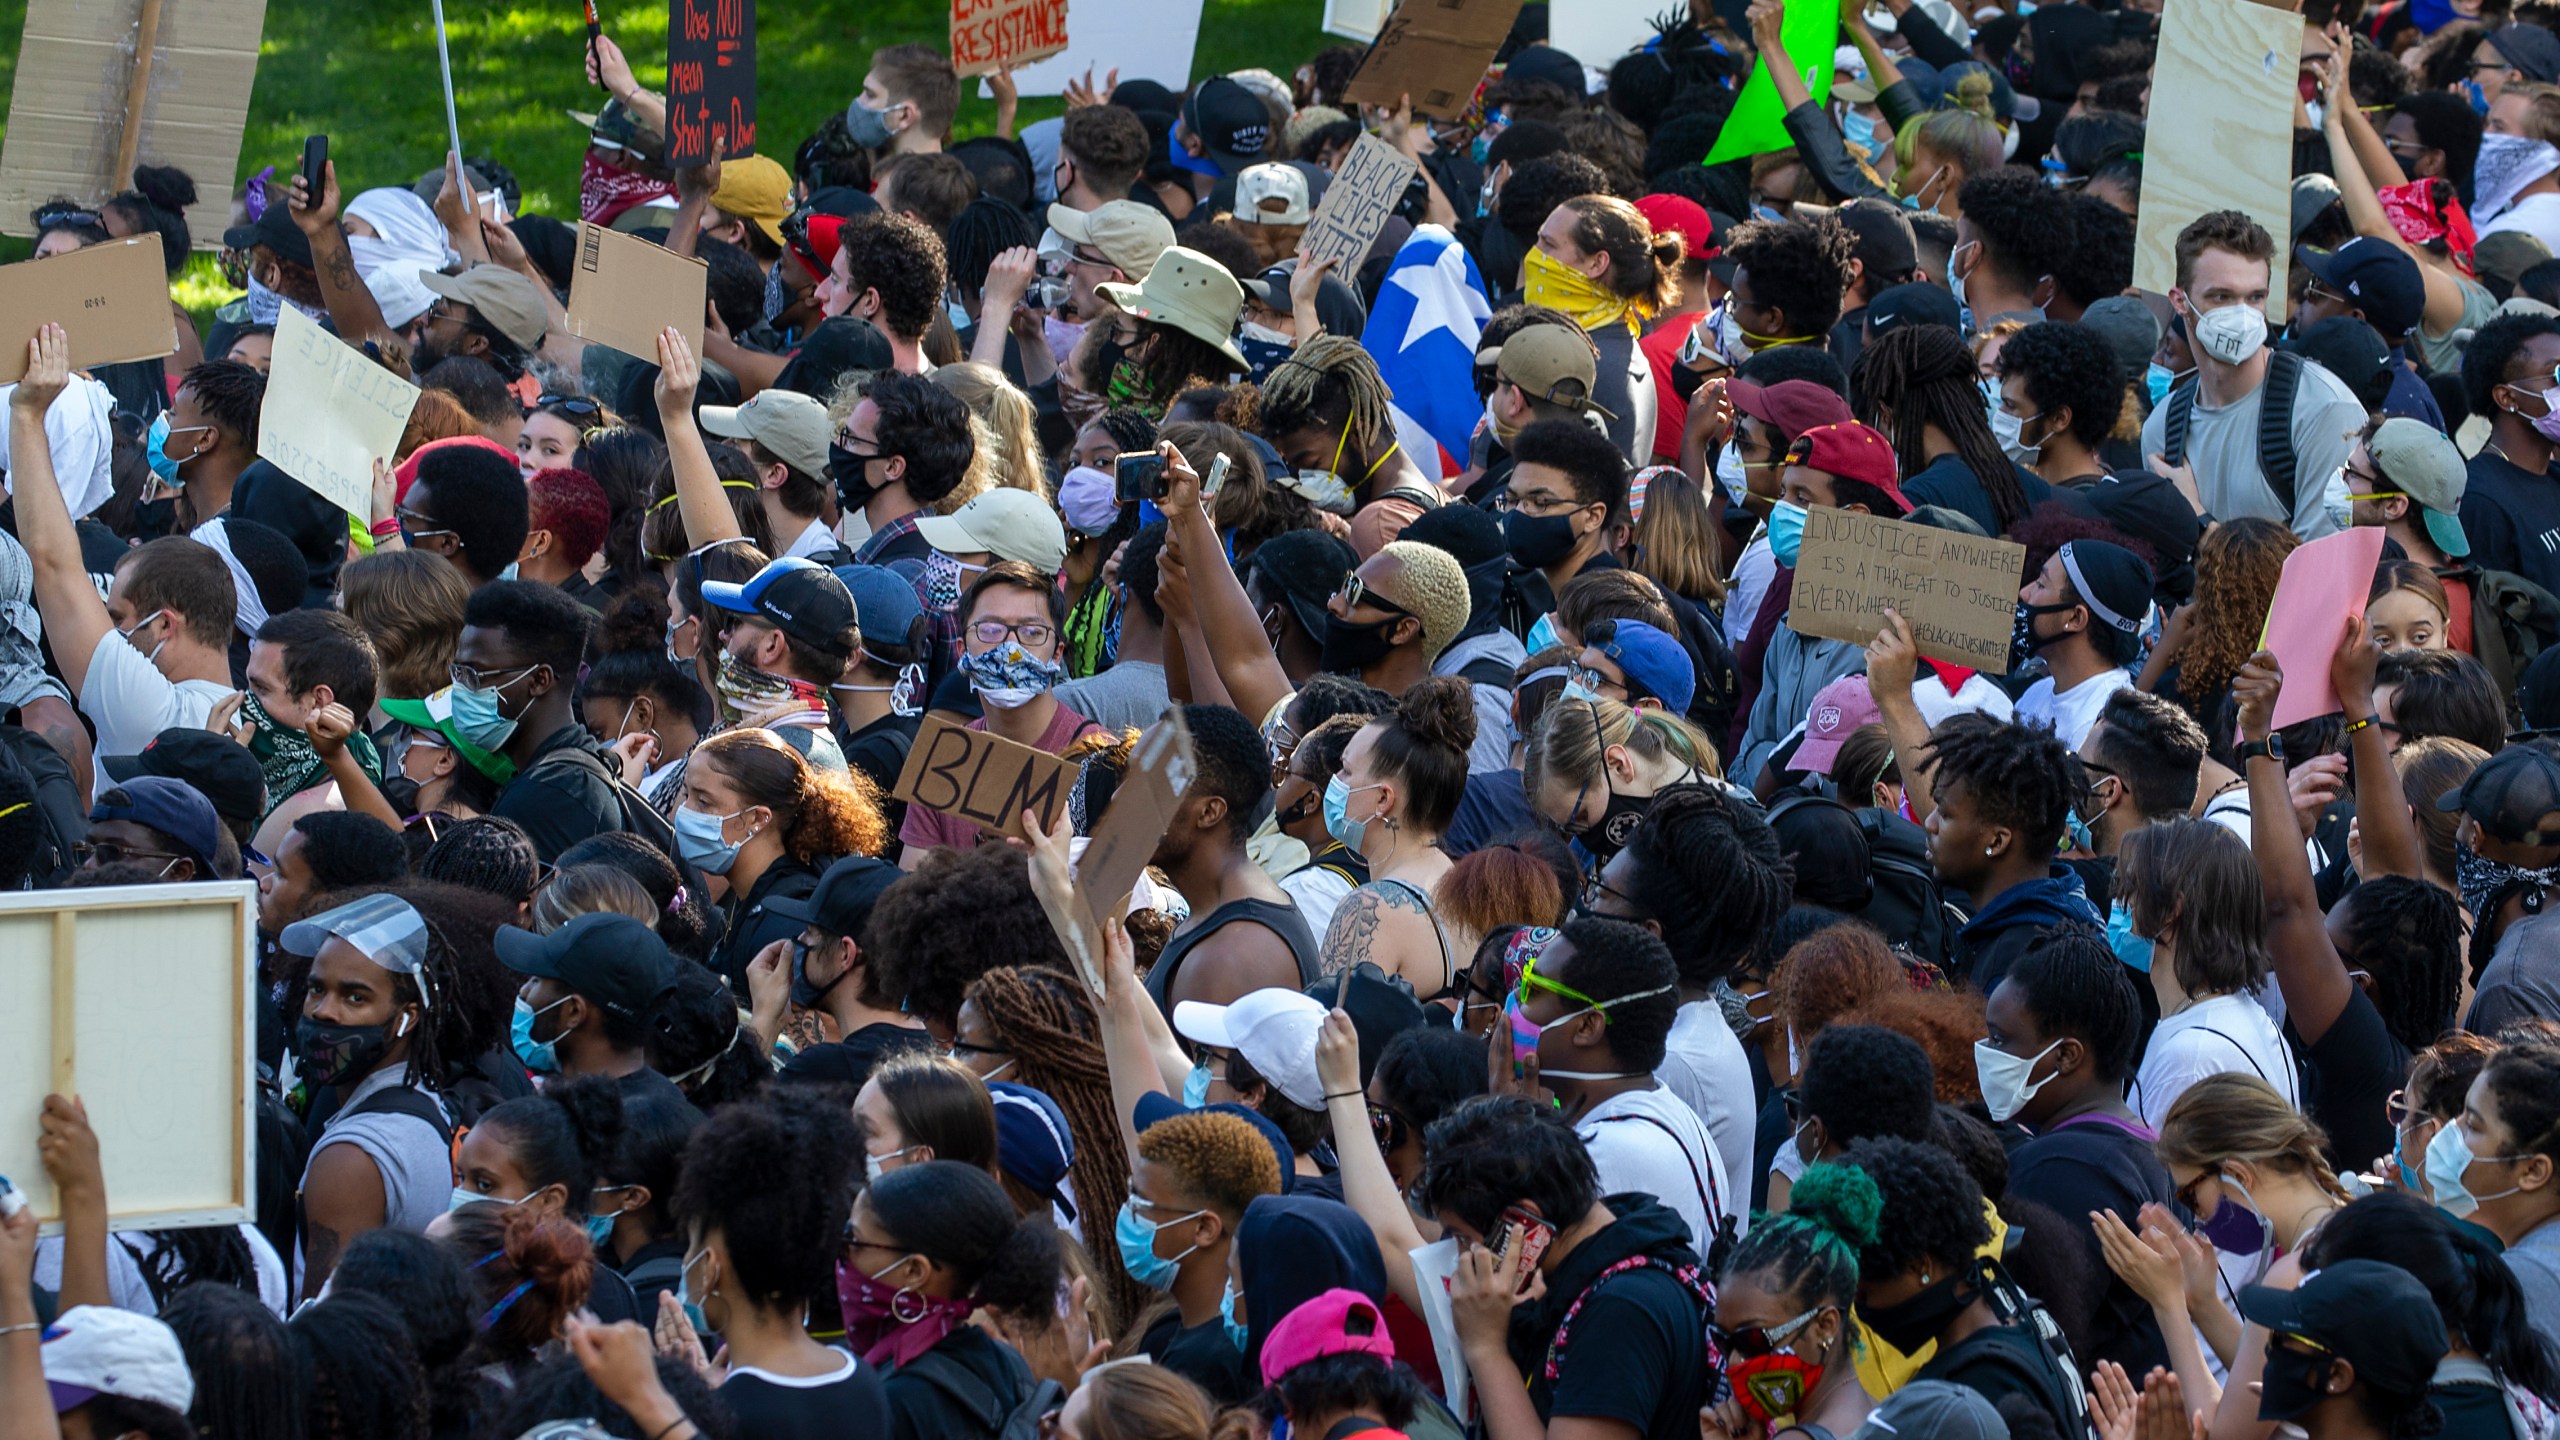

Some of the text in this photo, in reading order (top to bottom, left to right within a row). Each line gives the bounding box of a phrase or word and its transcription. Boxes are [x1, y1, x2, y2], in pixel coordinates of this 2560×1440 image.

[684, 0, 710, 42] Does
[953, 0, 1069, 69] RESISTANCE
[672, 97, 711, 160] Shoot
[731, 95, 757, 156] Down
[1341, 142, 1408, 206] BLACK
[1329, 186, 1389, 242] LIVES
[1304, 215, 1363, 282] MATTER
[2215, 332, 2243, 357] FDT
[1801, 510, 2022, 575] INJUSTICE ANYWHERE
[1797, 581, 1915, 619] EVERYWHERE
[1821, 556, 2017, 615] IS A THREAT TO JUSTICE
[1914, 623, 2008, 661] #BLACKLIVESMATTER
[911, 727, 1063, 838] BLM
